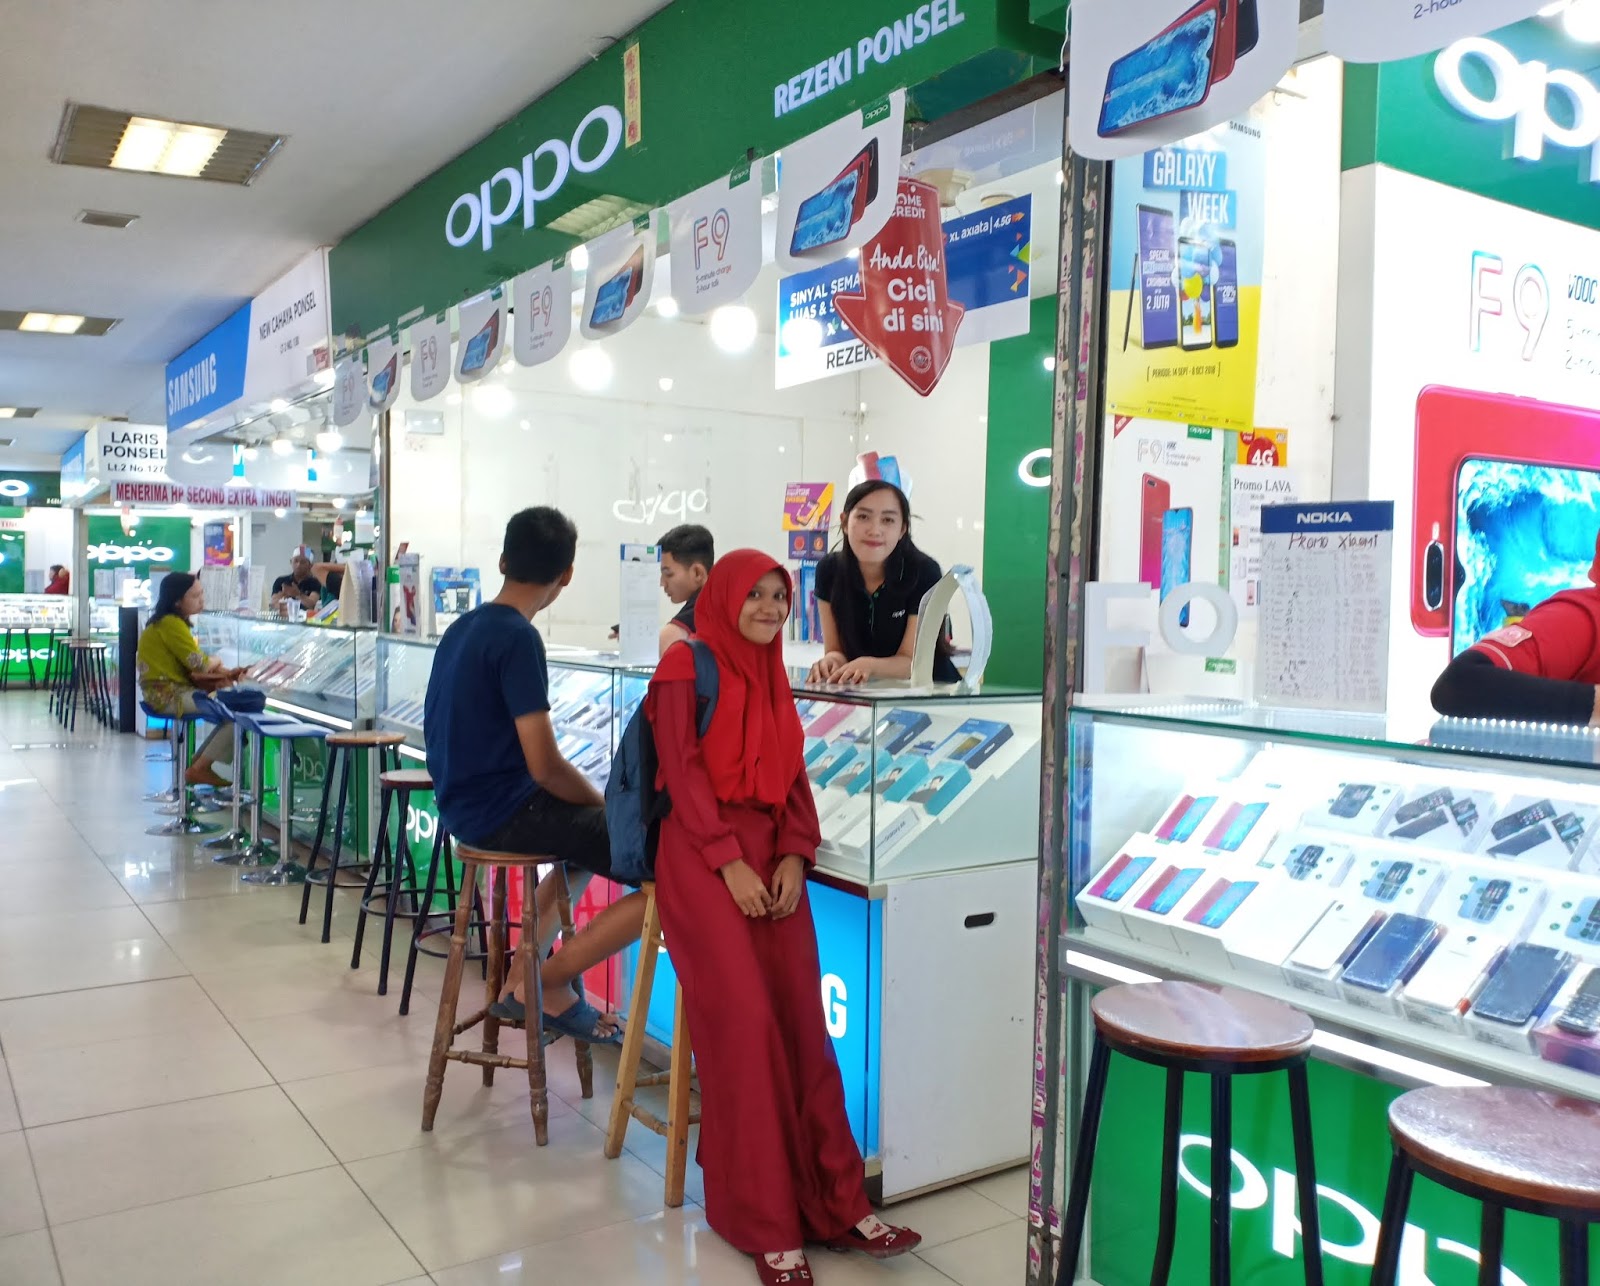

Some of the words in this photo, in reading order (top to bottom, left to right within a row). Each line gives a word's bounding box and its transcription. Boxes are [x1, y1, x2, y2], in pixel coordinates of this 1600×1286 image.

[1413, 0, 1462, 20] 2-hou
[774, 47, 851, 118] REZEKI
[857, 0, 965, 74] PONSEL
[864, 103, 889, 120] oppo
[1229, 121, 1261, 139] SAMSUNG
[446, 105, 623, 251] oppo
[1153, 151, 1217, 188] GALAXY
[892, 202, 926, 219] REDIT
[897, 195, 922, 207] OME
[1187, 192, 1230, 224] WEEK
[961, 220, 989, 238] axiata
[993, 213, 1012, 229] 4.5G
[693, 207, 731, 270] F9
[870, 242, 916, 269] Anda
[716, 264, 732, 277] charge
[790, 283, 828, 308] SINYAL
[830, 272, 861, 295] SEMA
[886, 278, 936, 303] Cicil
[1146, 295, 1152, 310] 2
[1152, 294, 1170, 310] JUTA
[259, 320, 271, 341] NEW
[271, 306, 294, 334] CAHAYA
[293, 290, 316, 319] PONSEL
[530, 285, 553, 332] F9
[1469, 250, 1550, 362] F9
[883, 307, 905, 332] di
[911, 309, 944, 333] sini
[827, 343, 879, 370] REZEK
[168, 352, 217, 416] SAMSUNG
[111, 431, 159, 446] LARIS
[103, 445, 168, 460] PONSEL
[1251, 448, 1274, 466] 4G
[116, 482, 169, 503] MENERIMA
[171, 485, 184, 502] HP
[186, 486, 225, 505] SECOND
[227, 488, 258, 507] EXTRA
[260, 489, 292, 507] TINGGI
[1233, 478, 1262, 492] Promo
[1264, 479, 1292, 493] LAVA
[1296, 511, 1353, 524] NOKIA
